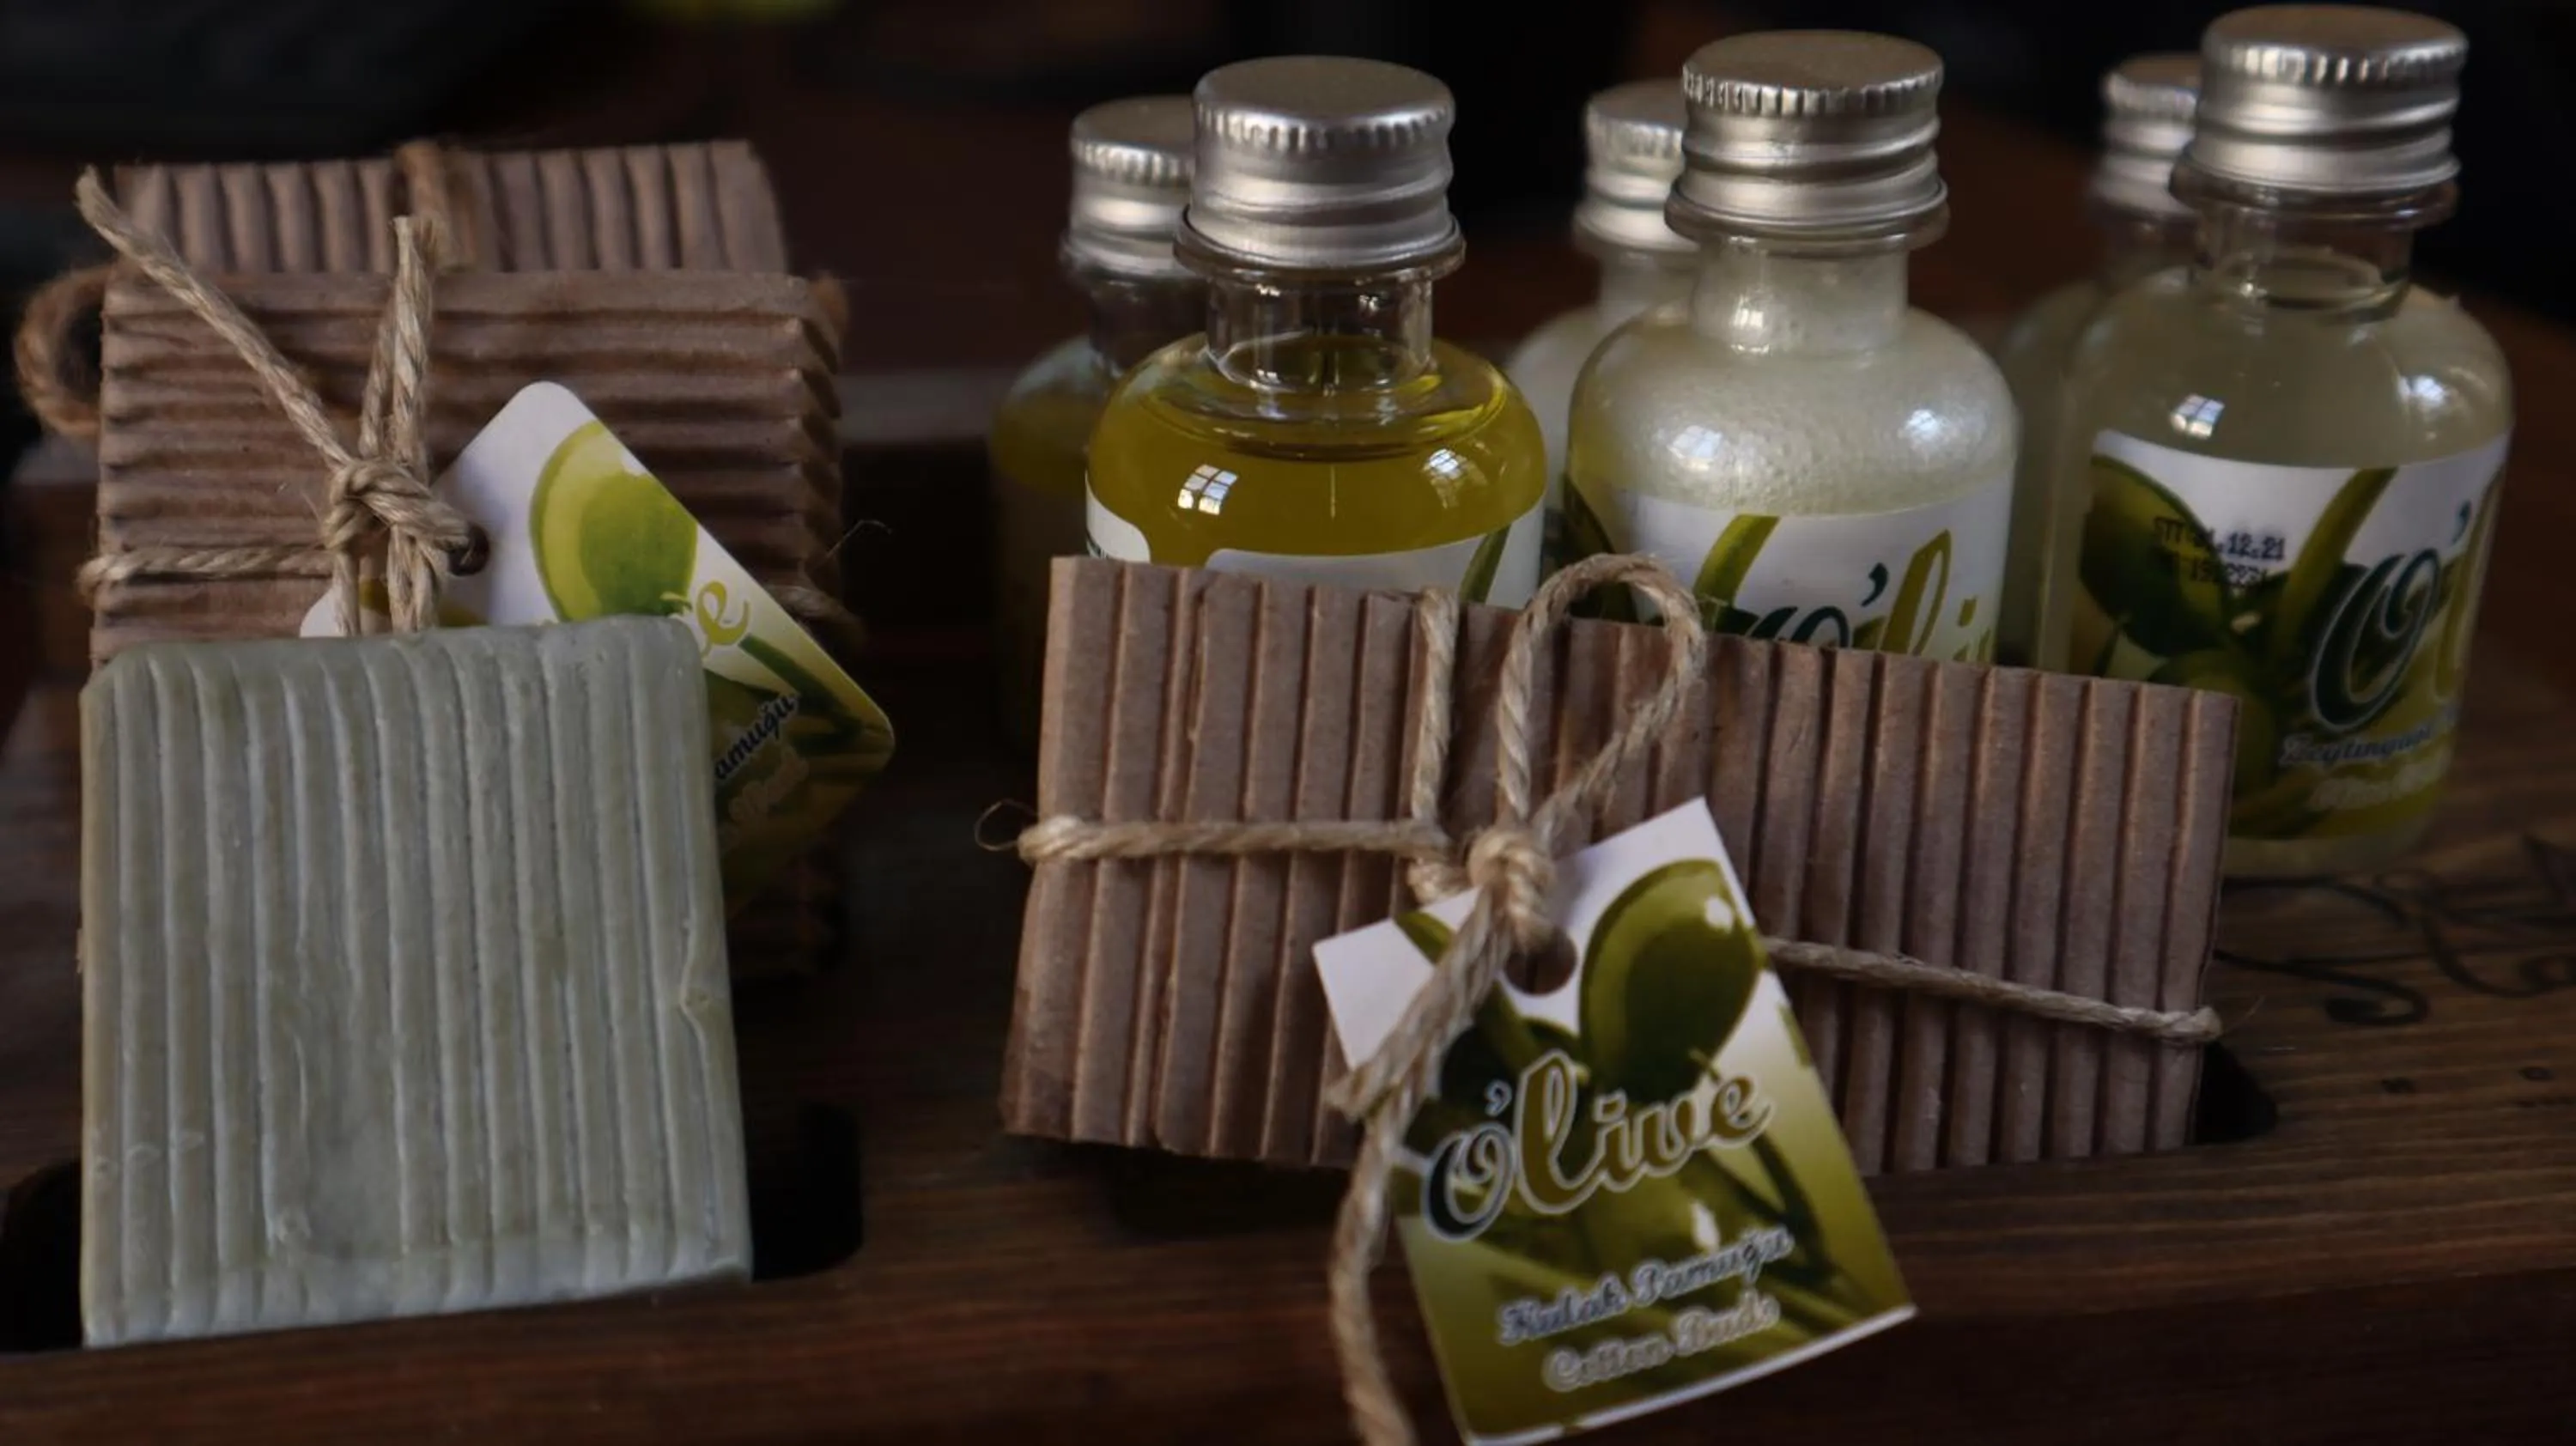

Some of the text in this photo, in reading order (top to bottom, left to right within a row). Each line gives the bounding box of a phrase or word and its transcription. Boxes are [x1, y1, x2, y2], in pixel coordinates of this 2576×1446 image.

[714, 690, 802, 782] amuğu
[1497, 1272, 1629, 1346] Kulak
[1541, 1333, 1674, 1393] Cotton
